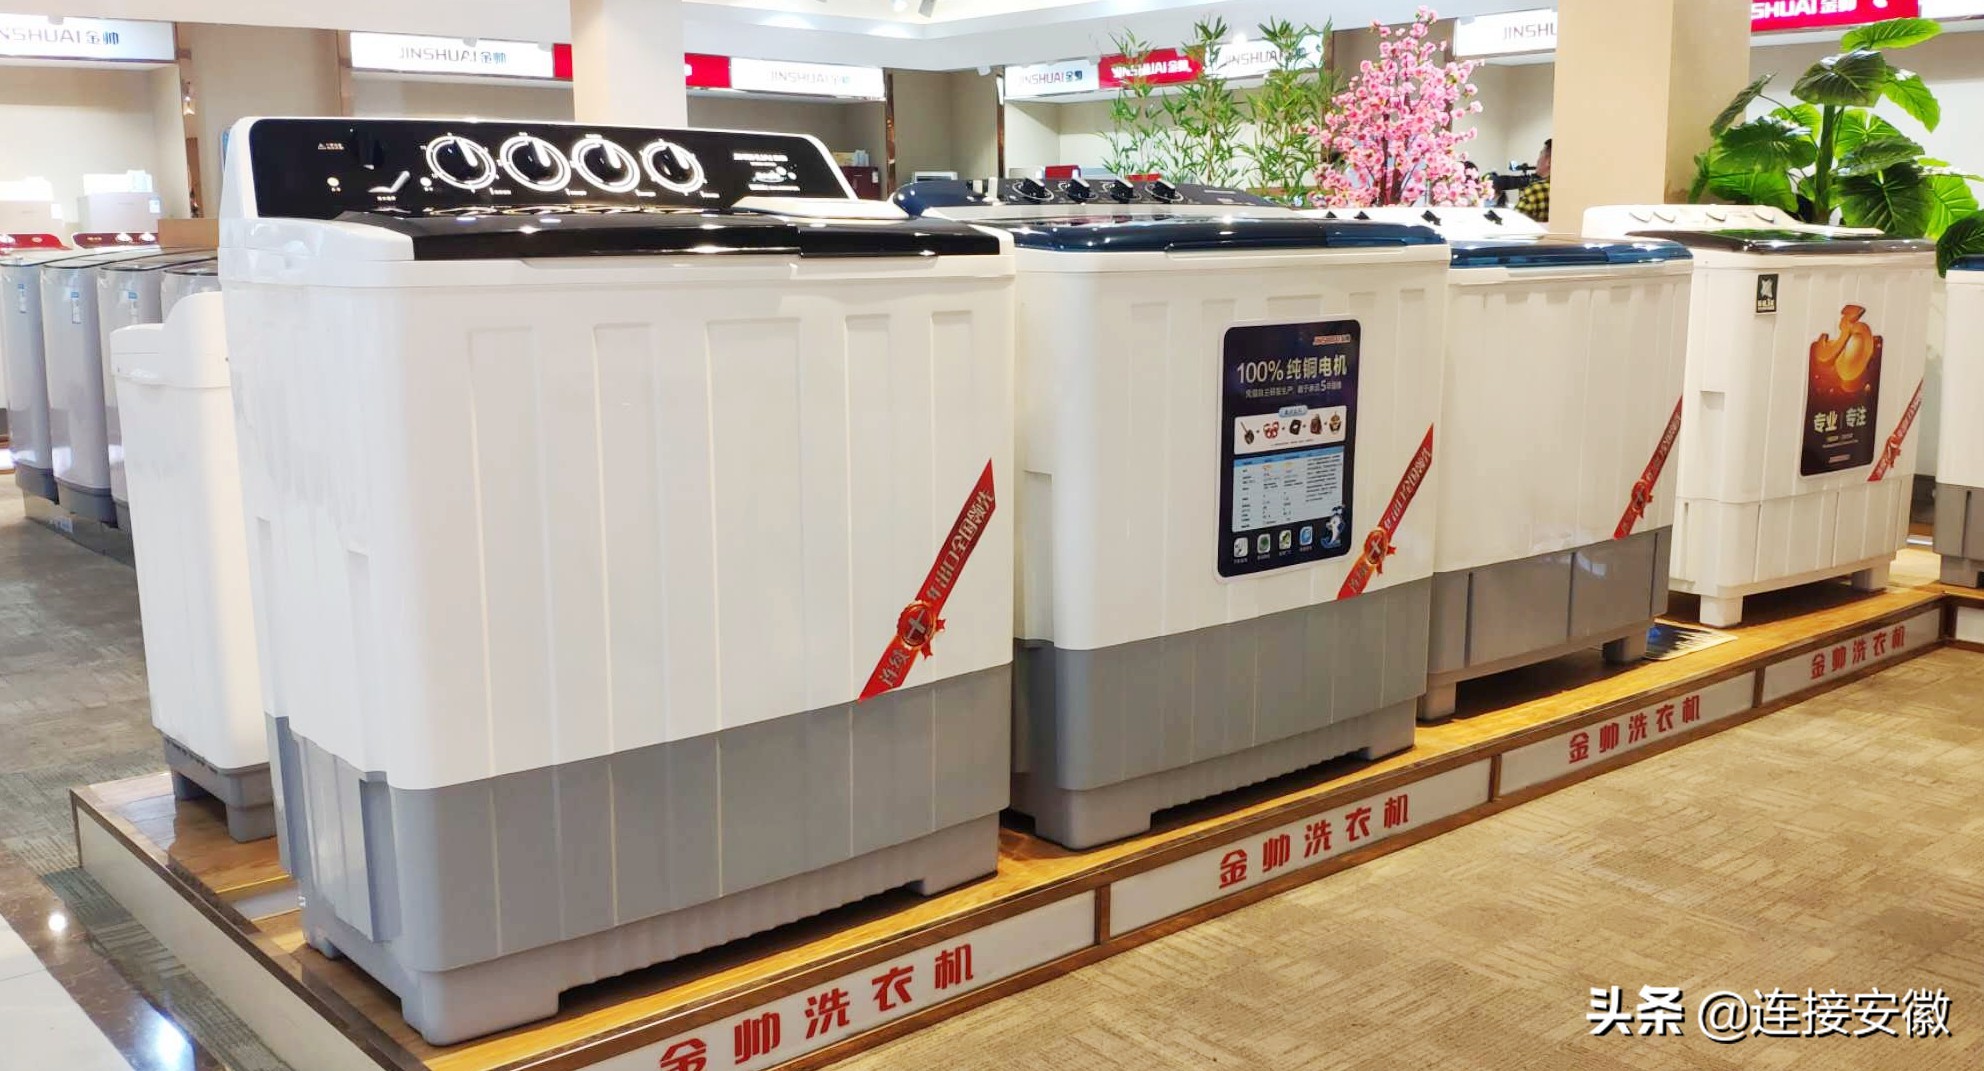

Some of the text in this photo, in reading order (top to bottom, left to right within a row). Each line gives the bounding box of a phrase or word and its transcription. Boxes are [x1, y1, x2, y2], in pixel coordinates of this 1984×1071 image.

[399, 47, 477, 63] JINSHUAI
[1236, 354, 1347, 384] 100% 纯铜电机
[1813, 404, 1868, 433] 专业 专注
[1810, 625, 1906, 680] 金帅洗衣机
[1568, 694, 1701, 764] 金帅洗衣机
[1219, 794, 1409, 889] 金帅洗衣机
